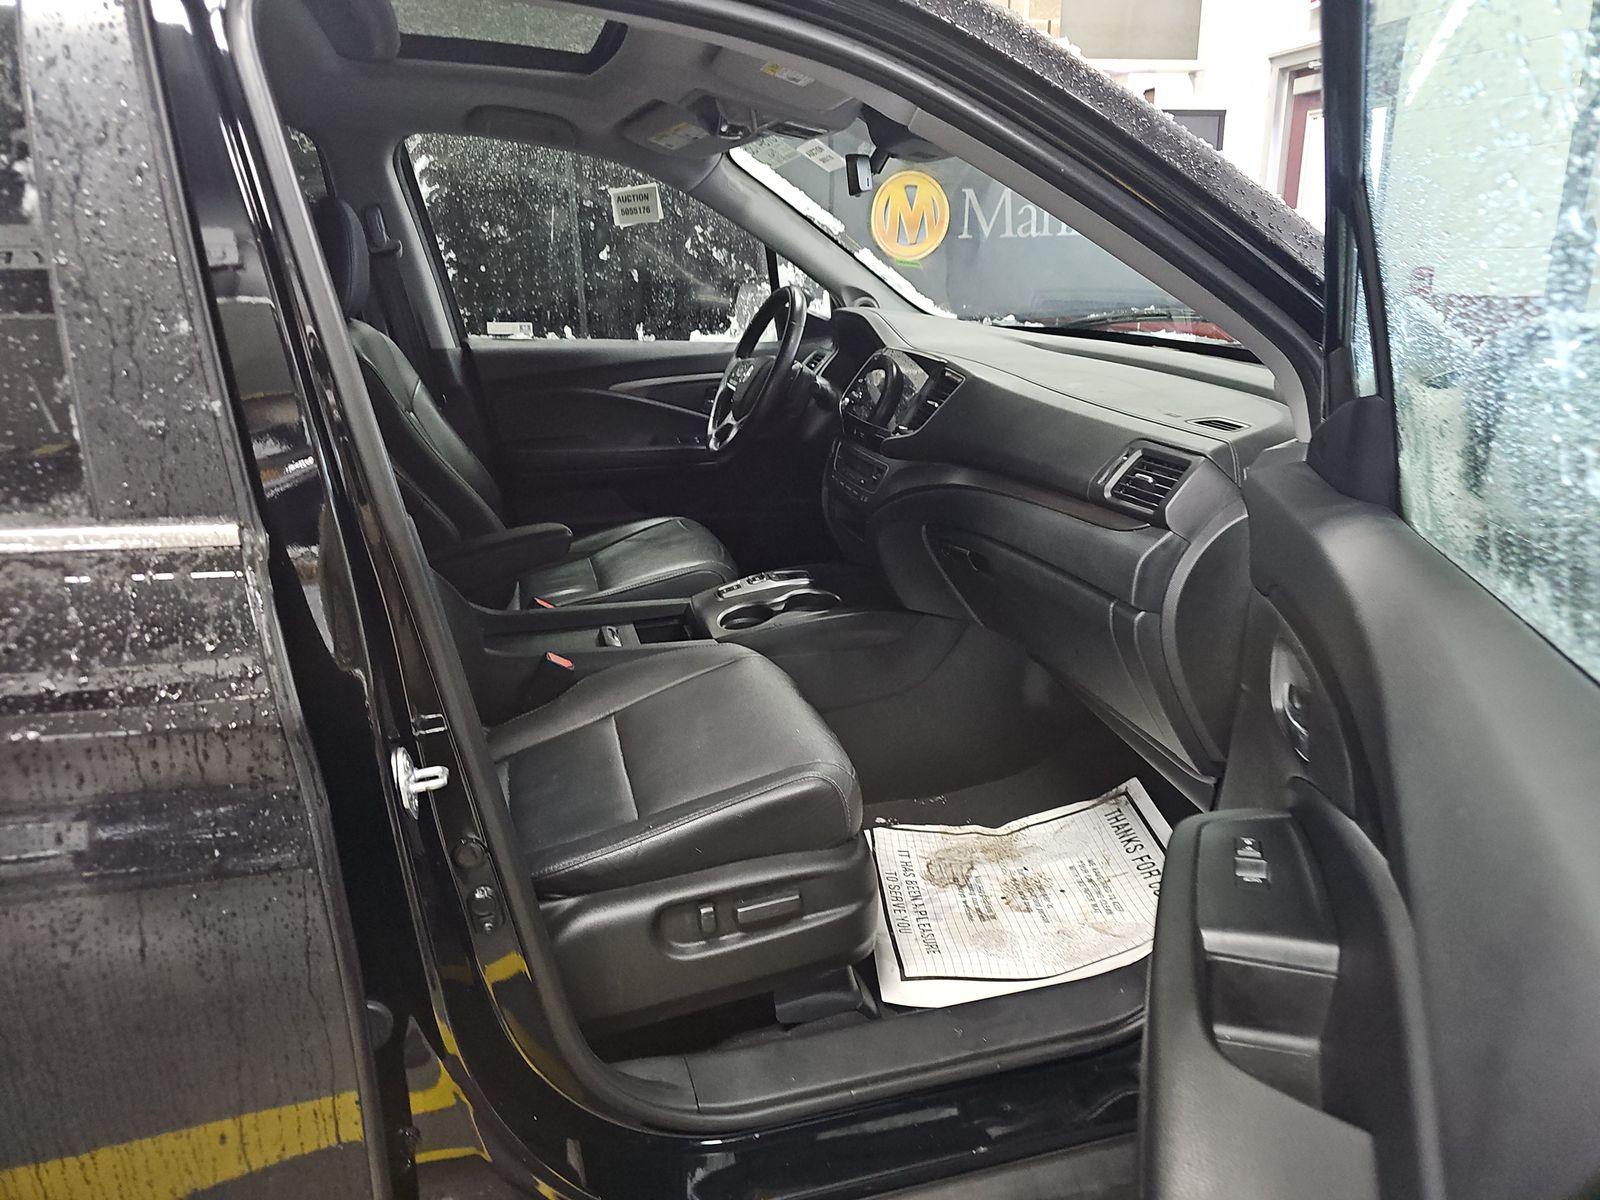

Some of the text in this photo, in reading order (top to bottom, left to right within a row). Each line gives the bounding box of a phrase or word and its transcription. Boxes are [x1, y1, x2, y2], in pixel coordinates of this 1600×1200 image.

[616, 192, 649, 204] AUCTION
[897, 849, 911, 858] IT
[1104, 807, 1144, 854] THANKS
[1131, 854, 1161, 880] FOR
[900, 860, 915, 878] HAS
[905, 880, 922, 902] BEEN
[885, 871, 913, 935] TO SERVE YOU
[913, 909, 941, 956] PLEASURE
